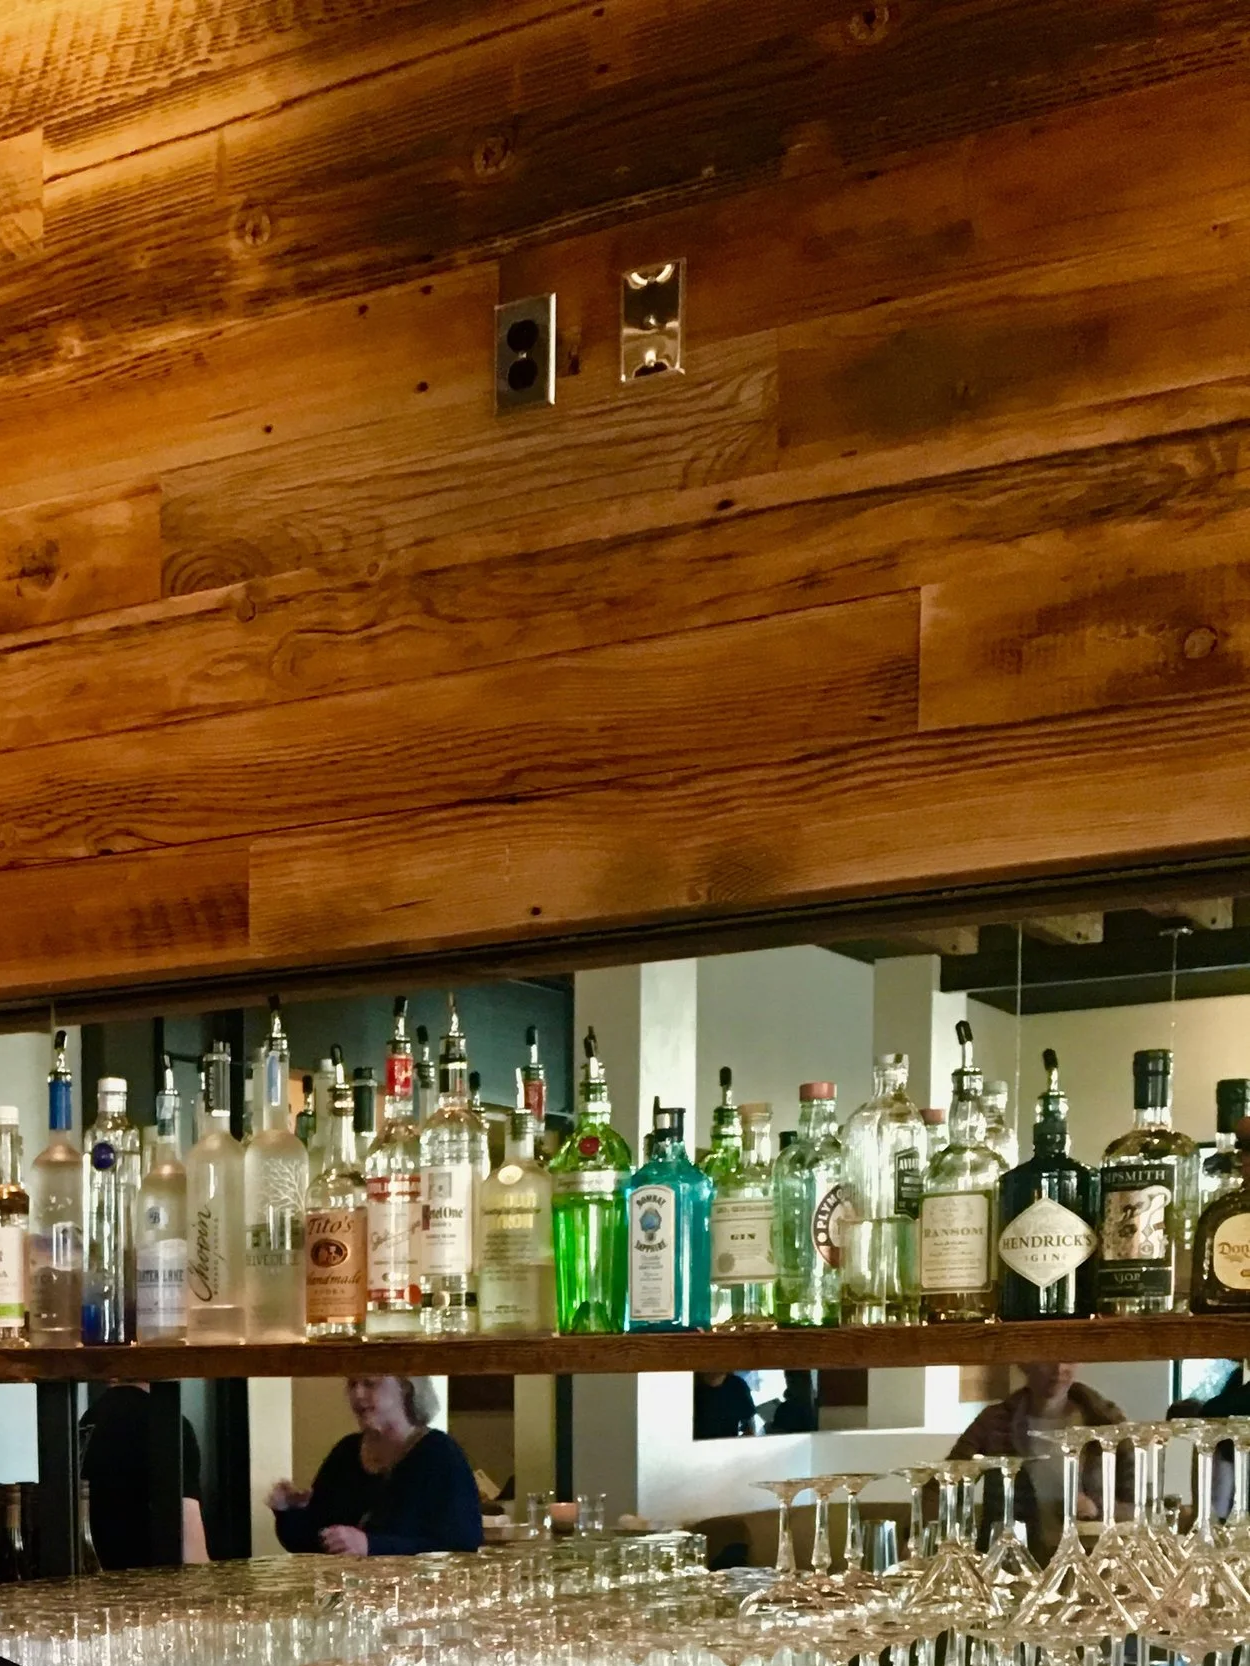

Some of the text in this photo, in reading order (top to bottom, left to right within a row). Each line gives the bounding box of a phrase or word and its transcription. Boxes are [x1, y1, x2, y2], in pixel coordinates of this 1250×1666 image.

[636, 1195, 667, 1209] BOMBAY
[444, 1207, 463, 1219] One
[308, 1216, 352, 1235] Tito's
[924, 1226, 984, 1238] RANSOM
[730, 1233, 756, 1241] GIN
[1002, 1234, 1092, 1250] HENDRICK'S
[188, 1205, 215, 1302] Chopin
[1031, 1253, 1060, 1262] GIN
